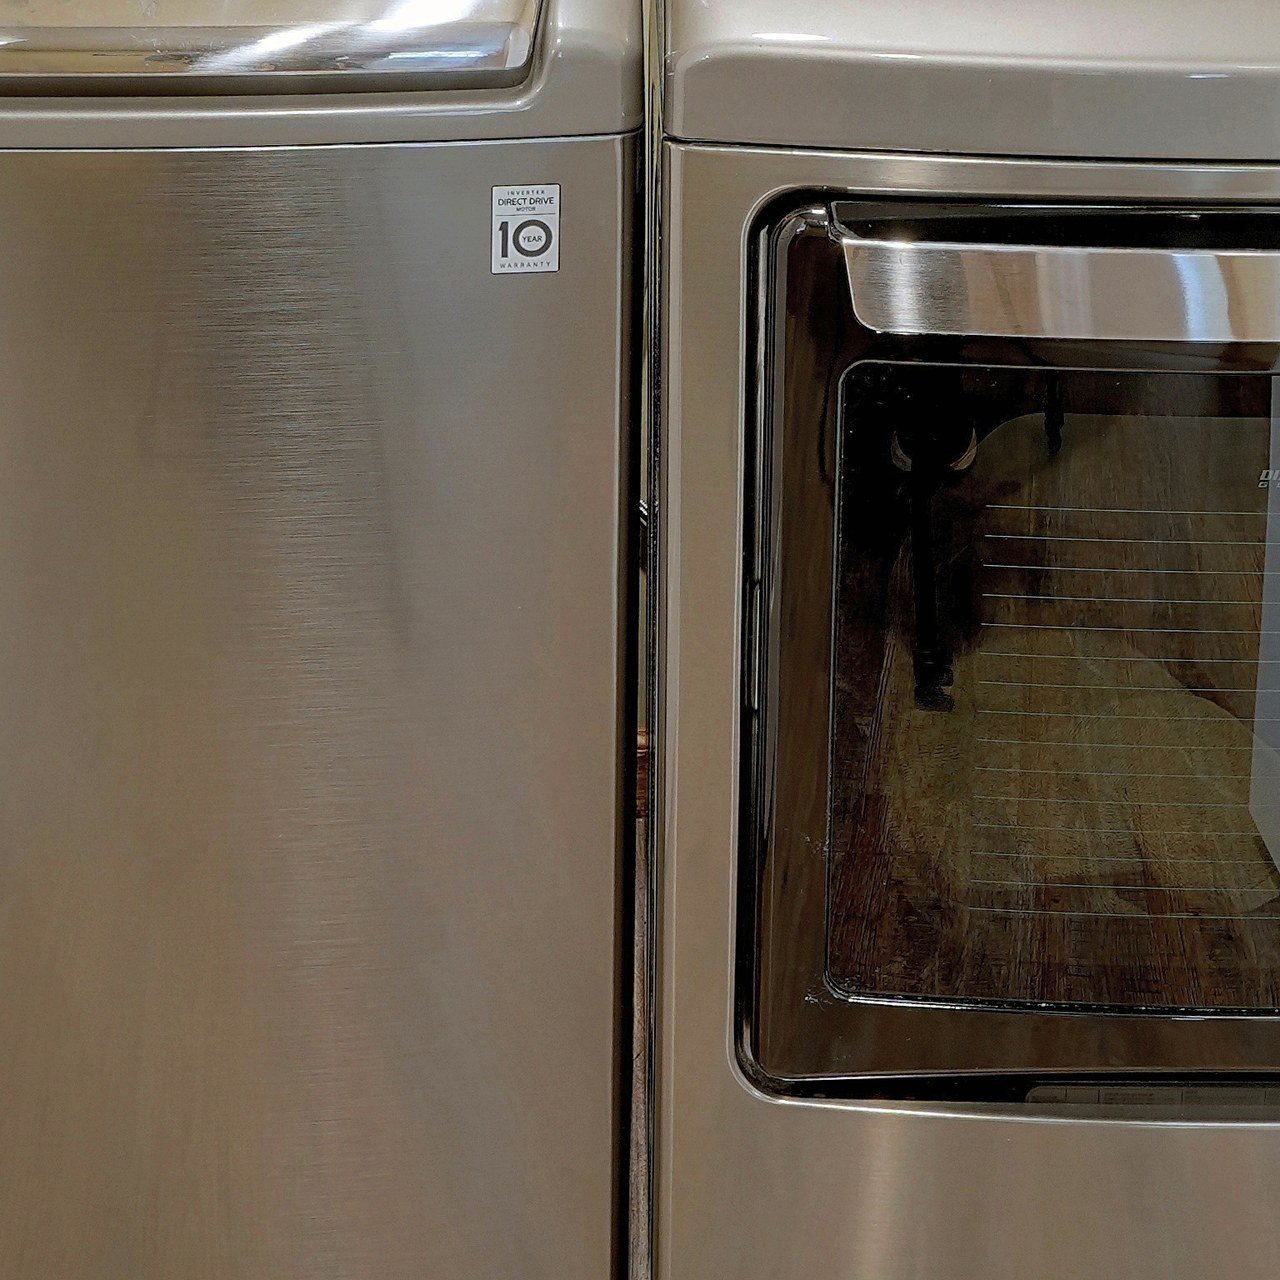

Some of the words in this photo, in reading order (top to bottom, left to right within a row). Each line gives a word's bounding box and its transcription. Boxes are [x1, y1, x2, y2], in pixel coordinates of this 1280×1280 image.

[497, 197, 528, 206] DIRECT
[528, 197, 554, 205] DRIVE
[498, 219, 553, 258] 10
[522, 235, 543, 243] YEAR
